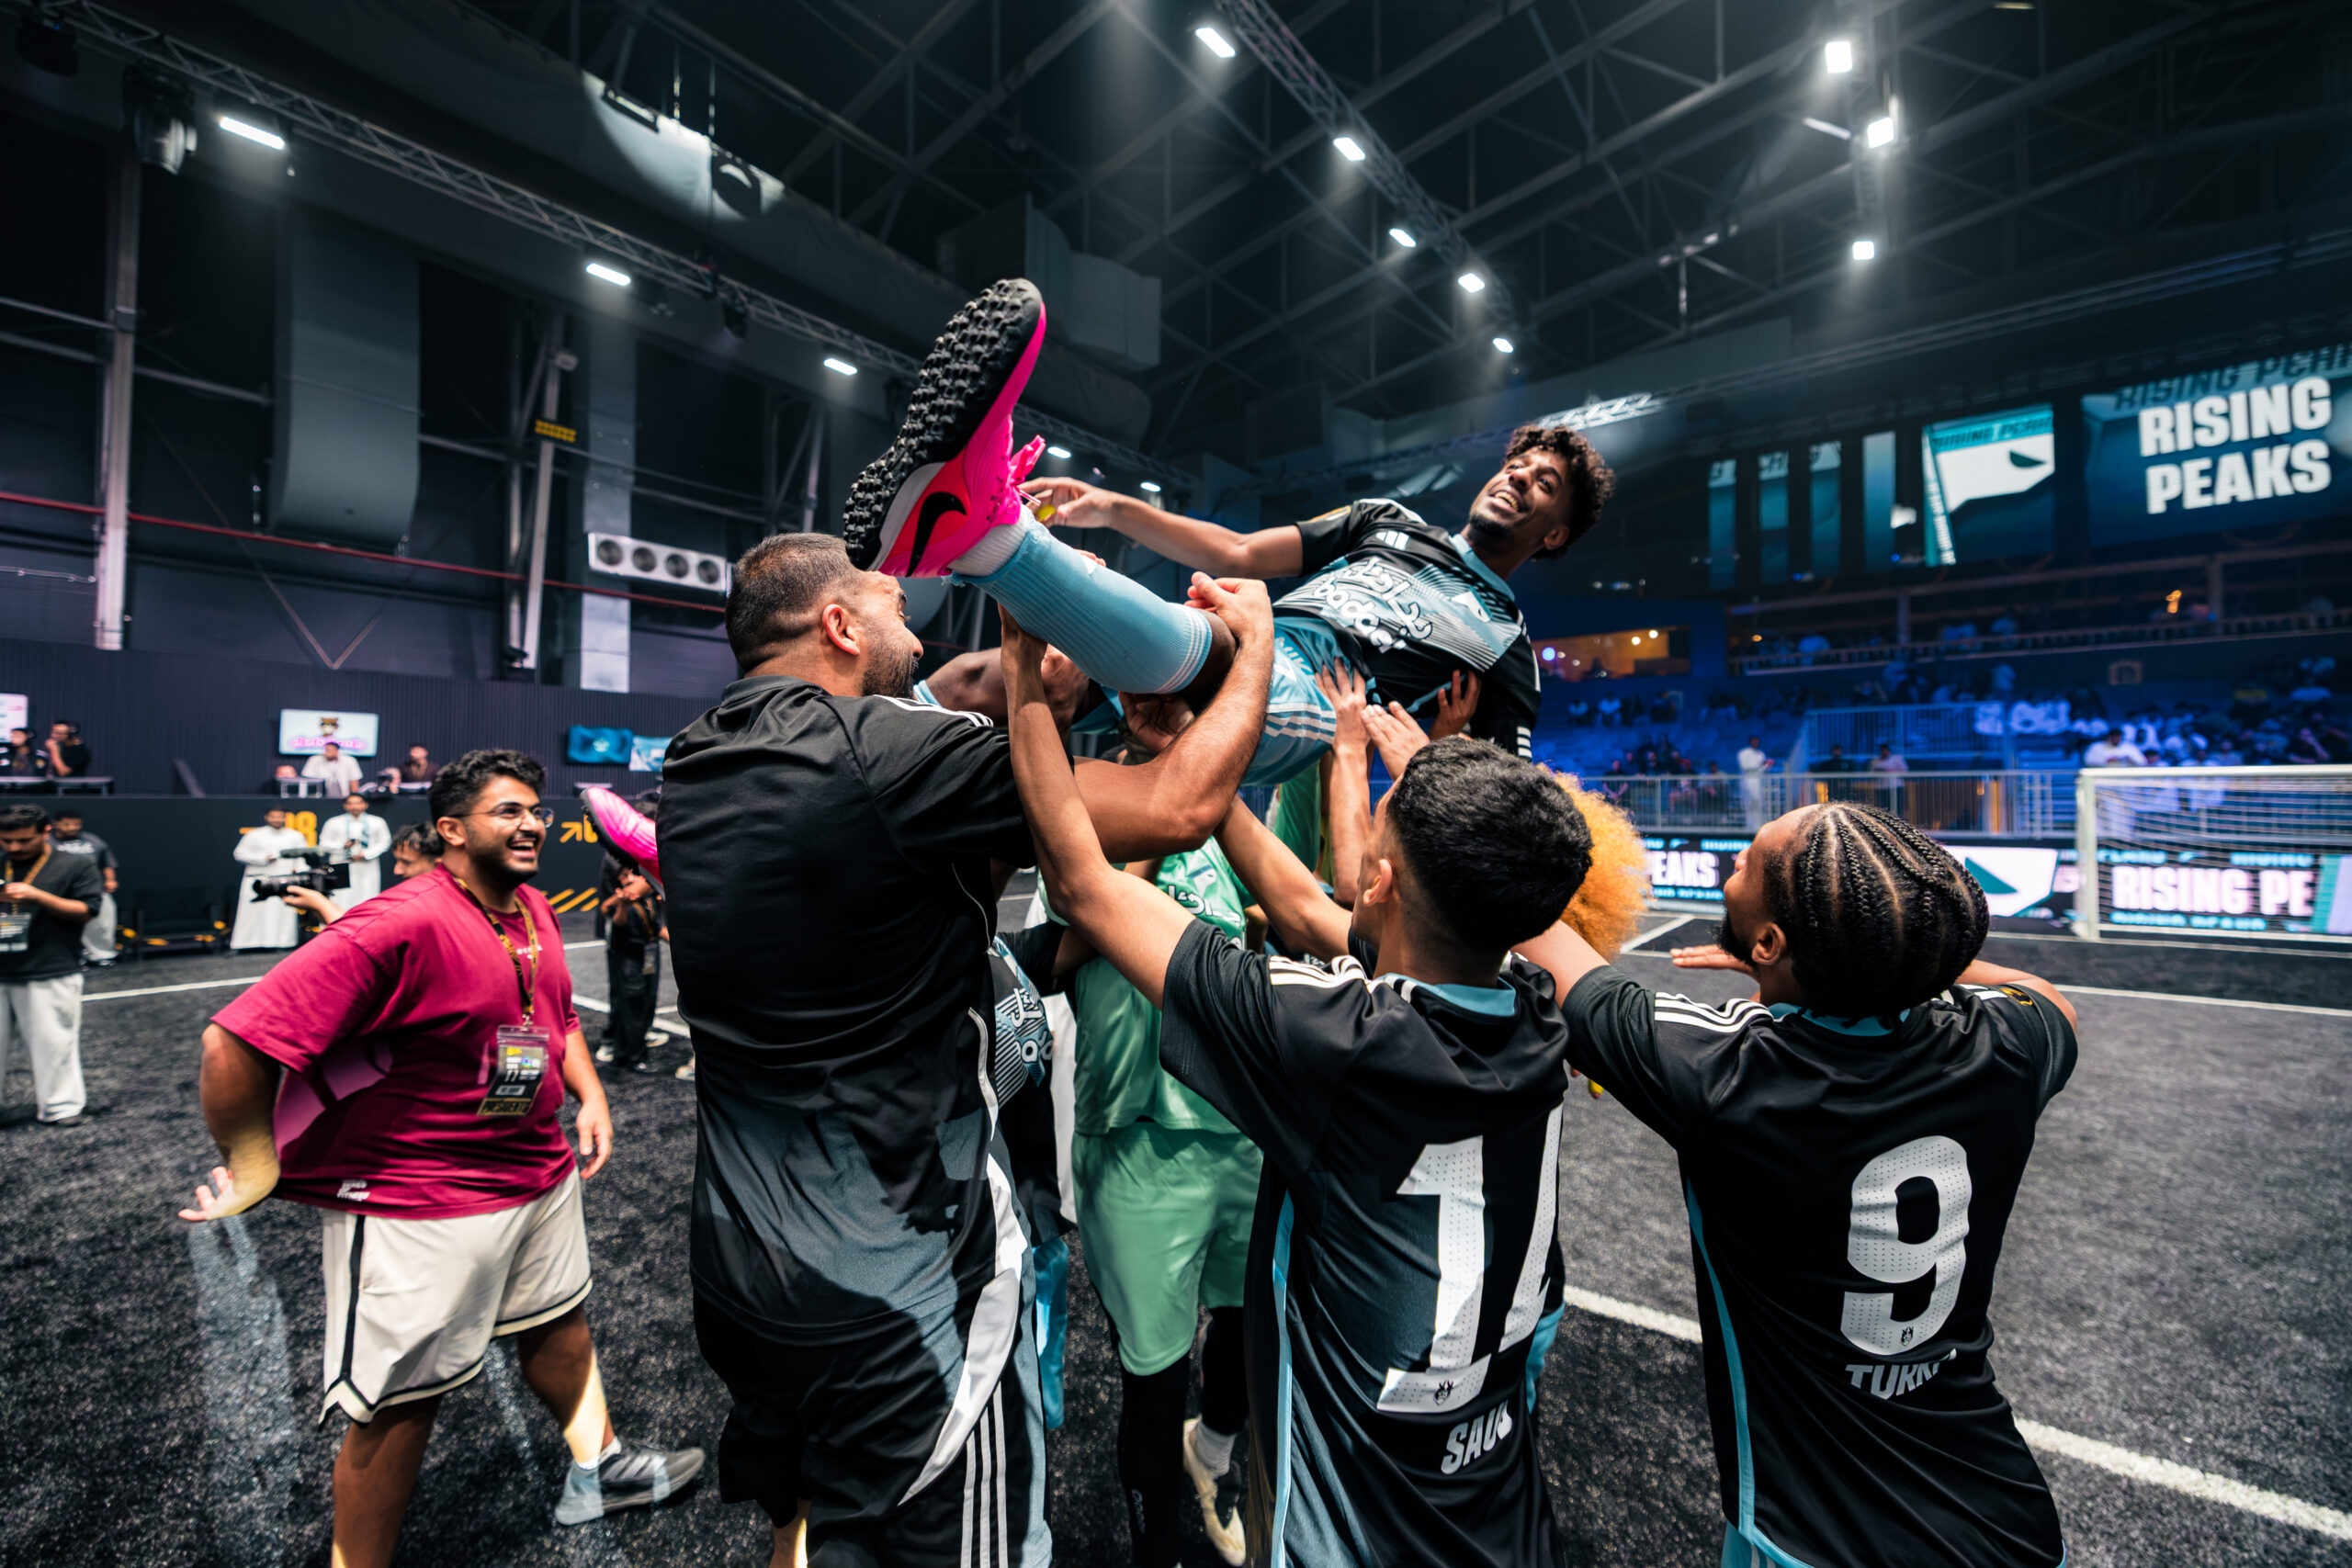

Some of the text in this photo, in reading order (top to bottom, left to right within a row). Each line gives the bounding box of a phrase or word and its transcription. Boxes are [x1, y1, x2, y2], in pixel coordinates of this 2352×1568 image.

[2139, 377, 2332, 457] RISING
[2146, 439, 2332, 514] PEAKS
[2112, 865, 2253, 914] RISING
[1840, 1134, 1973, 1355] 9
